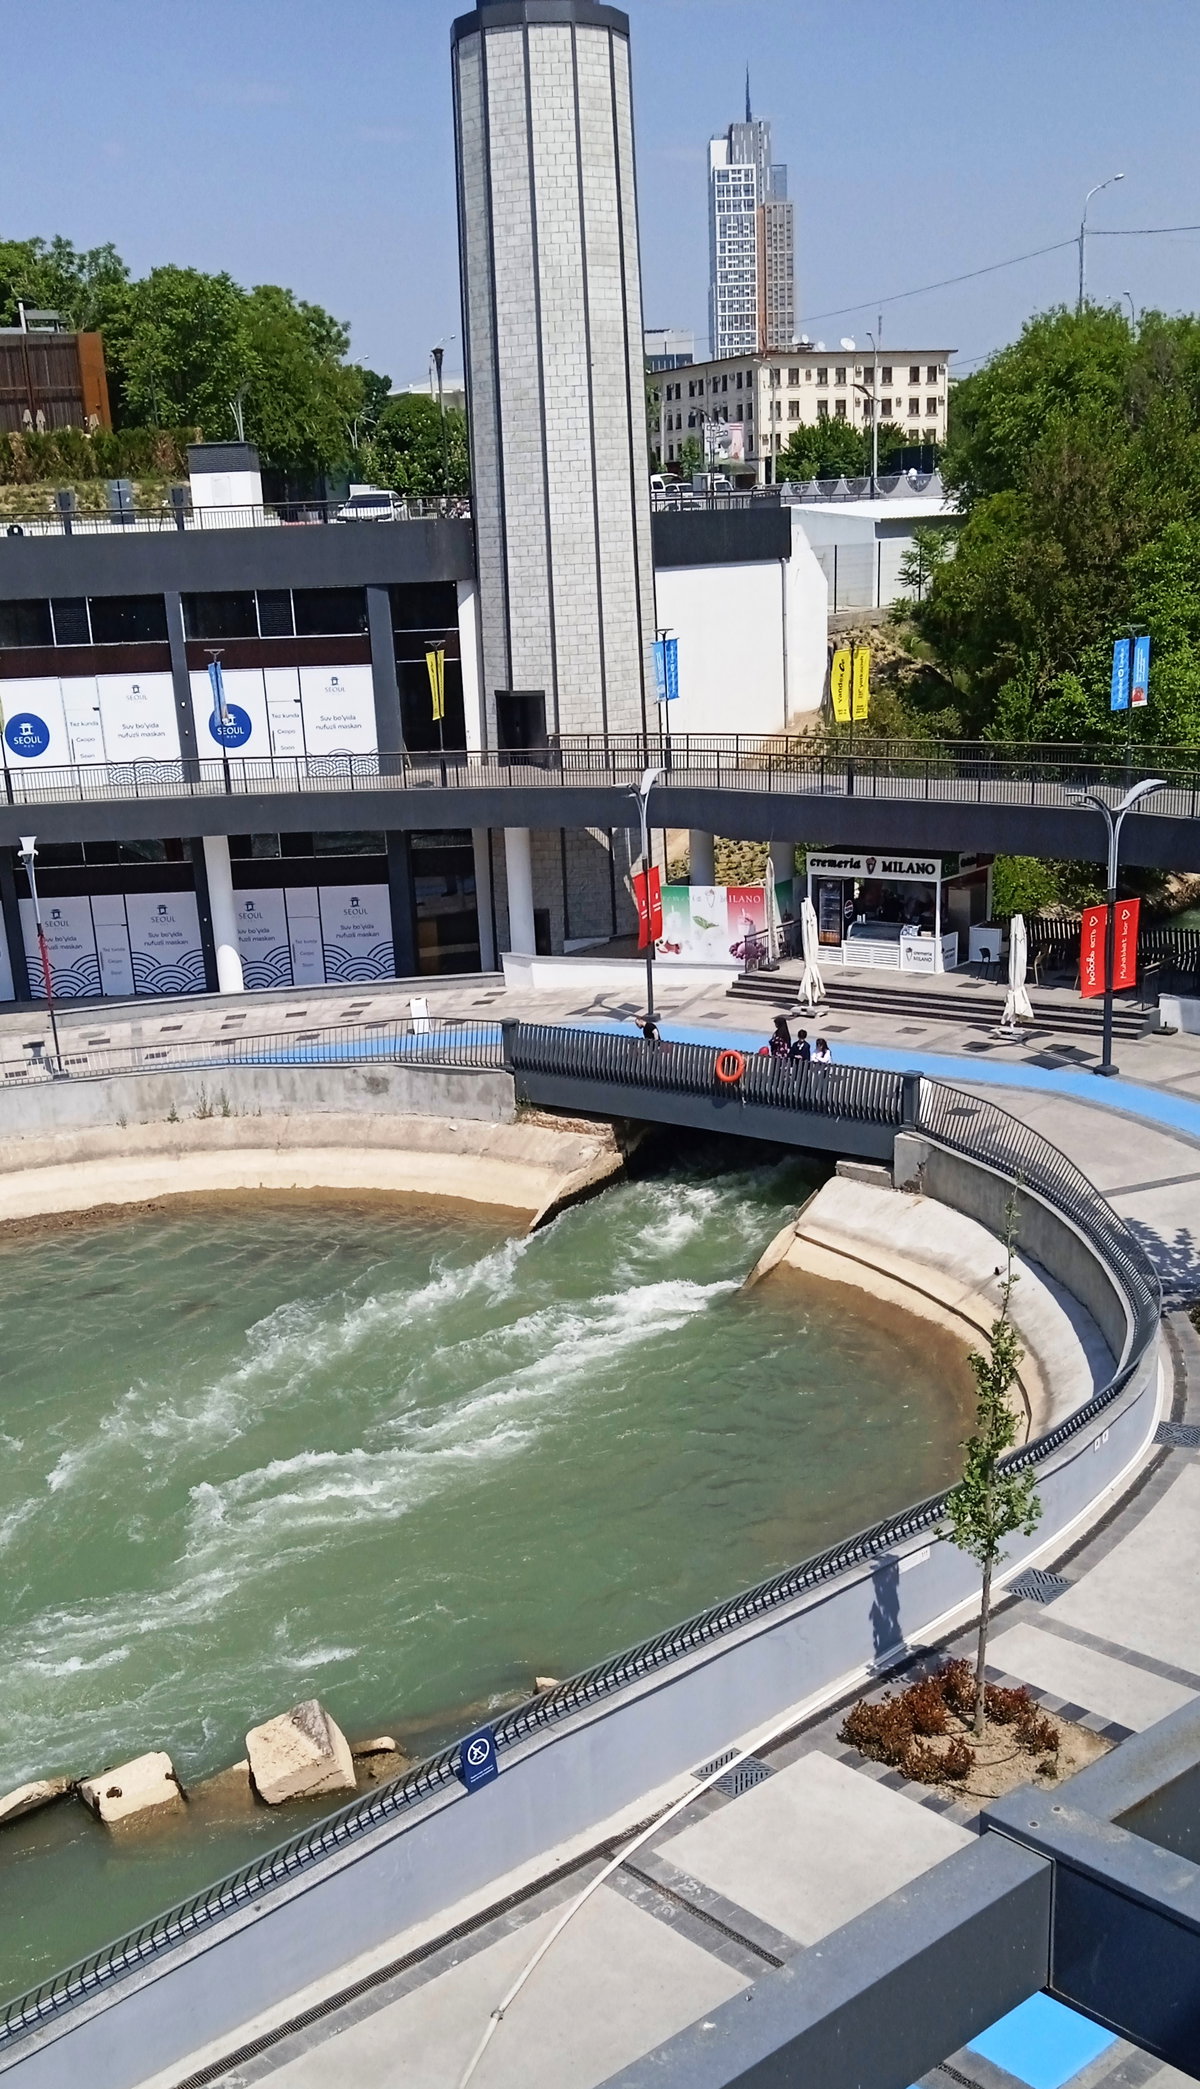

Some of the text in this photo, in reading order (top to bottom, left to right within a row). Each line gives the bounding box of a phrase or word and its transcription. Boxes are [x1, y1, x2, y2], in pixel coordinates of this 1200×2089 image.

[217, 726, 244, 736] SEOUL
[13, 735, 42, 745] SEOUL
[810, 857, 861, 869] cremeria
[881, 860, 936, 875] MILANO
